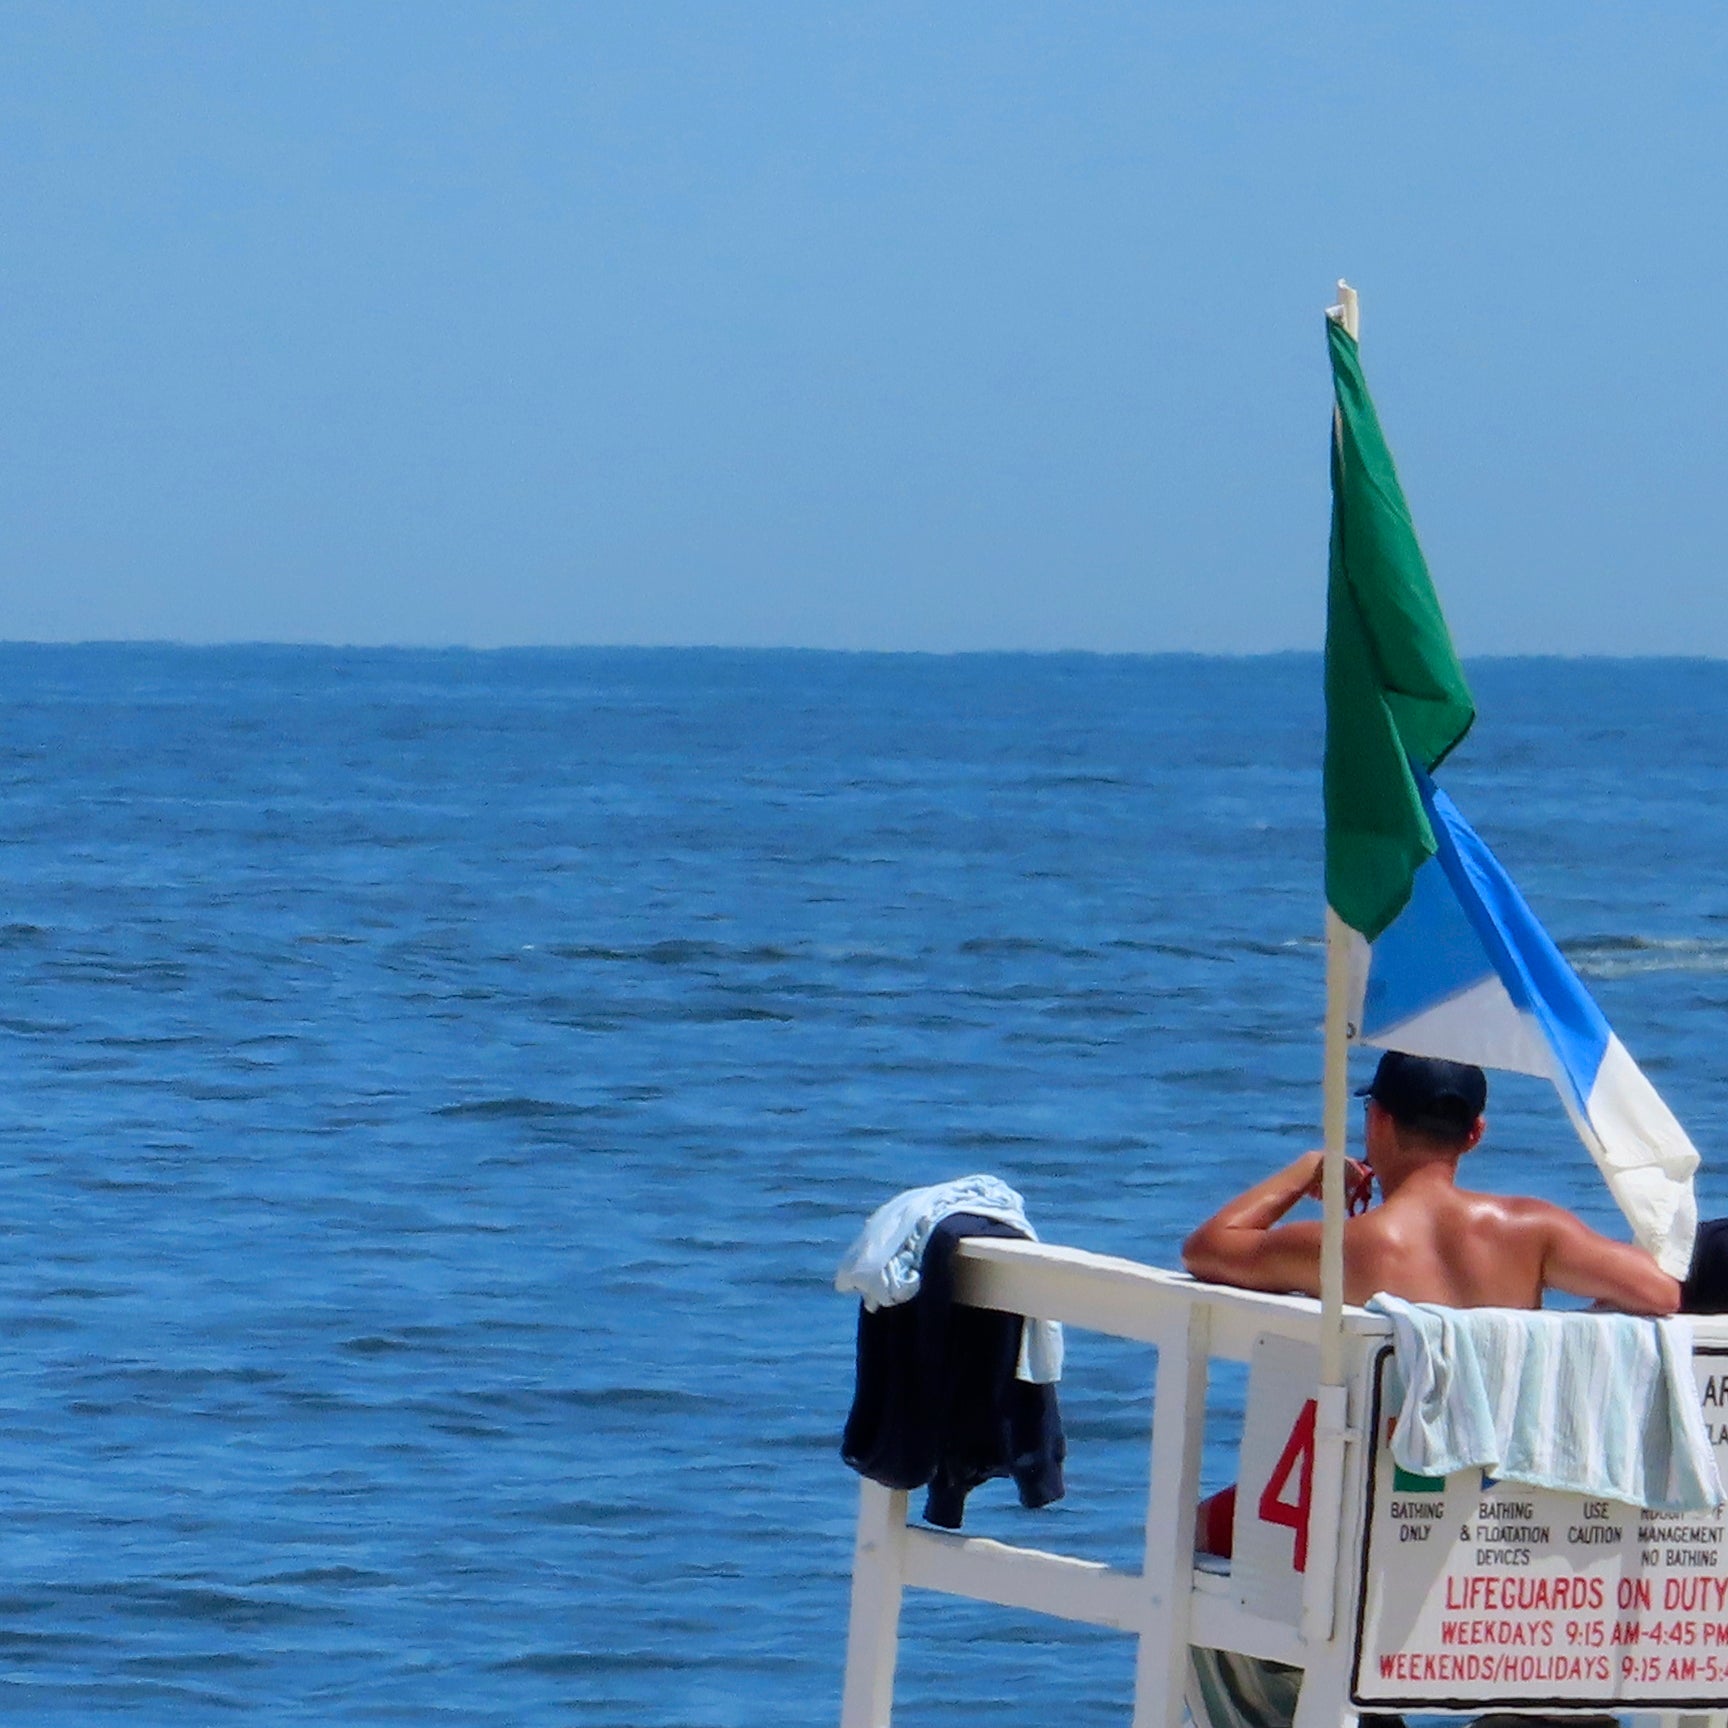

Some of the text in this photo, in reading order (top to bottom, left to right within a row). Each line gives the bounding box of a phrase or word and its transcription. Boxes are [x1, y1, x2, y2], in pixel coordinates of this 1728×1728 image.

[1258, 1398, 1318, 1573] 4
[1390, 1501, 1446, 1520] BATHING
[1479, 1502, 1534, 1520] BATHING
[1583, 1502, 1610, 1520] USE
[1399, 1524, 1431, 1542] ONLY
[1459, 1525, 1550, 1543] & FLOATATION
[1567, 1526, 1624, 1544] CAUTION
[1637, 1526, 1725, 1544] MANAGEMENT
[1476, 1549, 1531, 1566] DEVICES
[1641, 1549, 1719, 1567] NO BATHING
[1444, 1576, 1604, 1611] LIFEGUARDS
[1617, 1577, 1651, 1611] ON
[1441, 1620, 1554, 1647] WEEKDAYS
[1565, 1620, 1604, 1647] 9:15
[1610, 1620, 1697, 1647] AM-4:45
[1379, 1653, 1610, 1682] WEEKENDS/HOLIDAYS
[1621, 1657, 1661, 1682] 9:15
